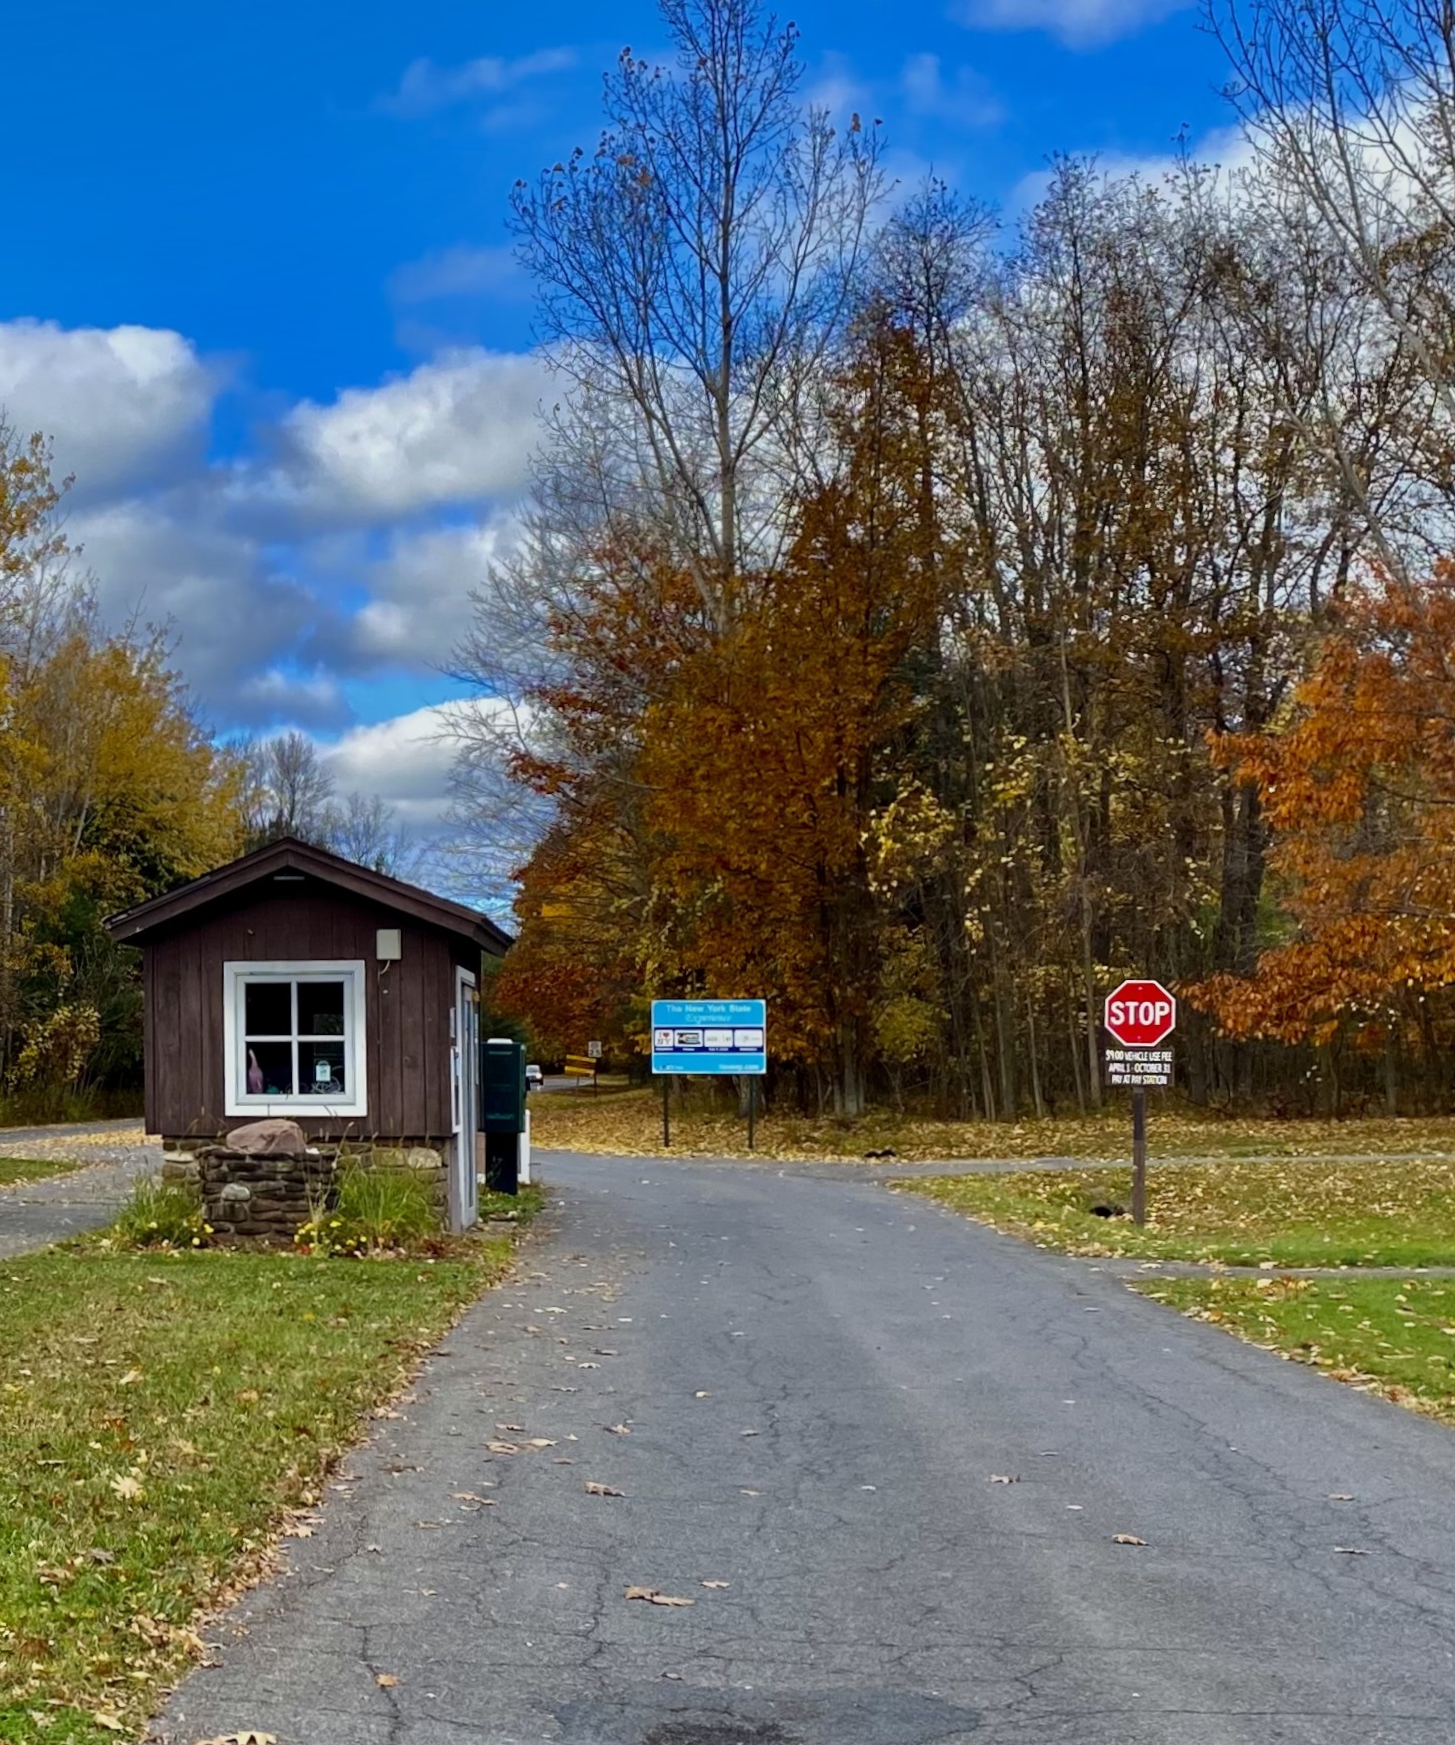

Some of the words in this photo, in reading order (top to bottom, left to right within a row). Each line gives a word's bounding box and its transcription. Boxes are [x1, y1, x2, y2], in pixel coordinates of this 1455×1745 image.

[666, 1004, 683, 1013] The
[685, 1004, 704, 1013] New
[707, 1004, 726, 1013] York
[729, 1004, 752, 1013] State
[1109, 1000, 1171, 1026] STOP
[1125, 1051, 1148, 1061] VEHICLE
[1149, 1051, 1161, 1061] USE
[1162, 1051, 1173, 1061] FEE
[1108, 1063, 1125, 1073] APRIL
[1134, 1063, 1162, 1073] OCTOBER
[1143, 1075, 1167, 1085] STATION
